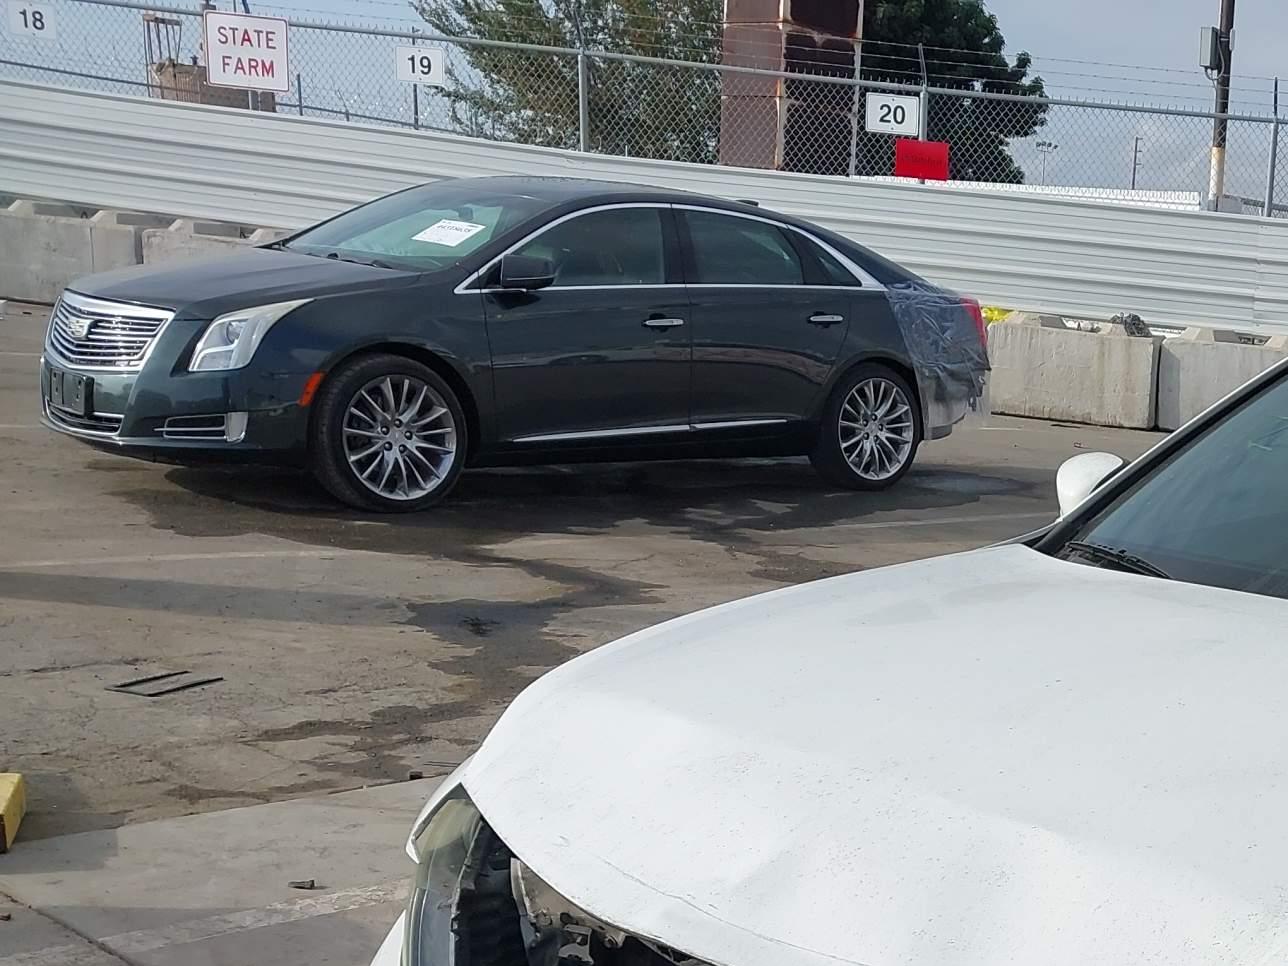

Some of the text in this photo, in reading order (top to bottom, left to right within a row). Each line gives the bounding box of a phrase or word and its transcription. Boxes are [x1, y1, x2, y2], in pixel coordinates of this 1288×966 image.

[18, 9, 46, 31] 18
[217, 27, 278, 51] STATE
[221, 56, 276, 80] FARM
[406, 54, 433, 76] 19
[878, 103, 907, 126] 20
